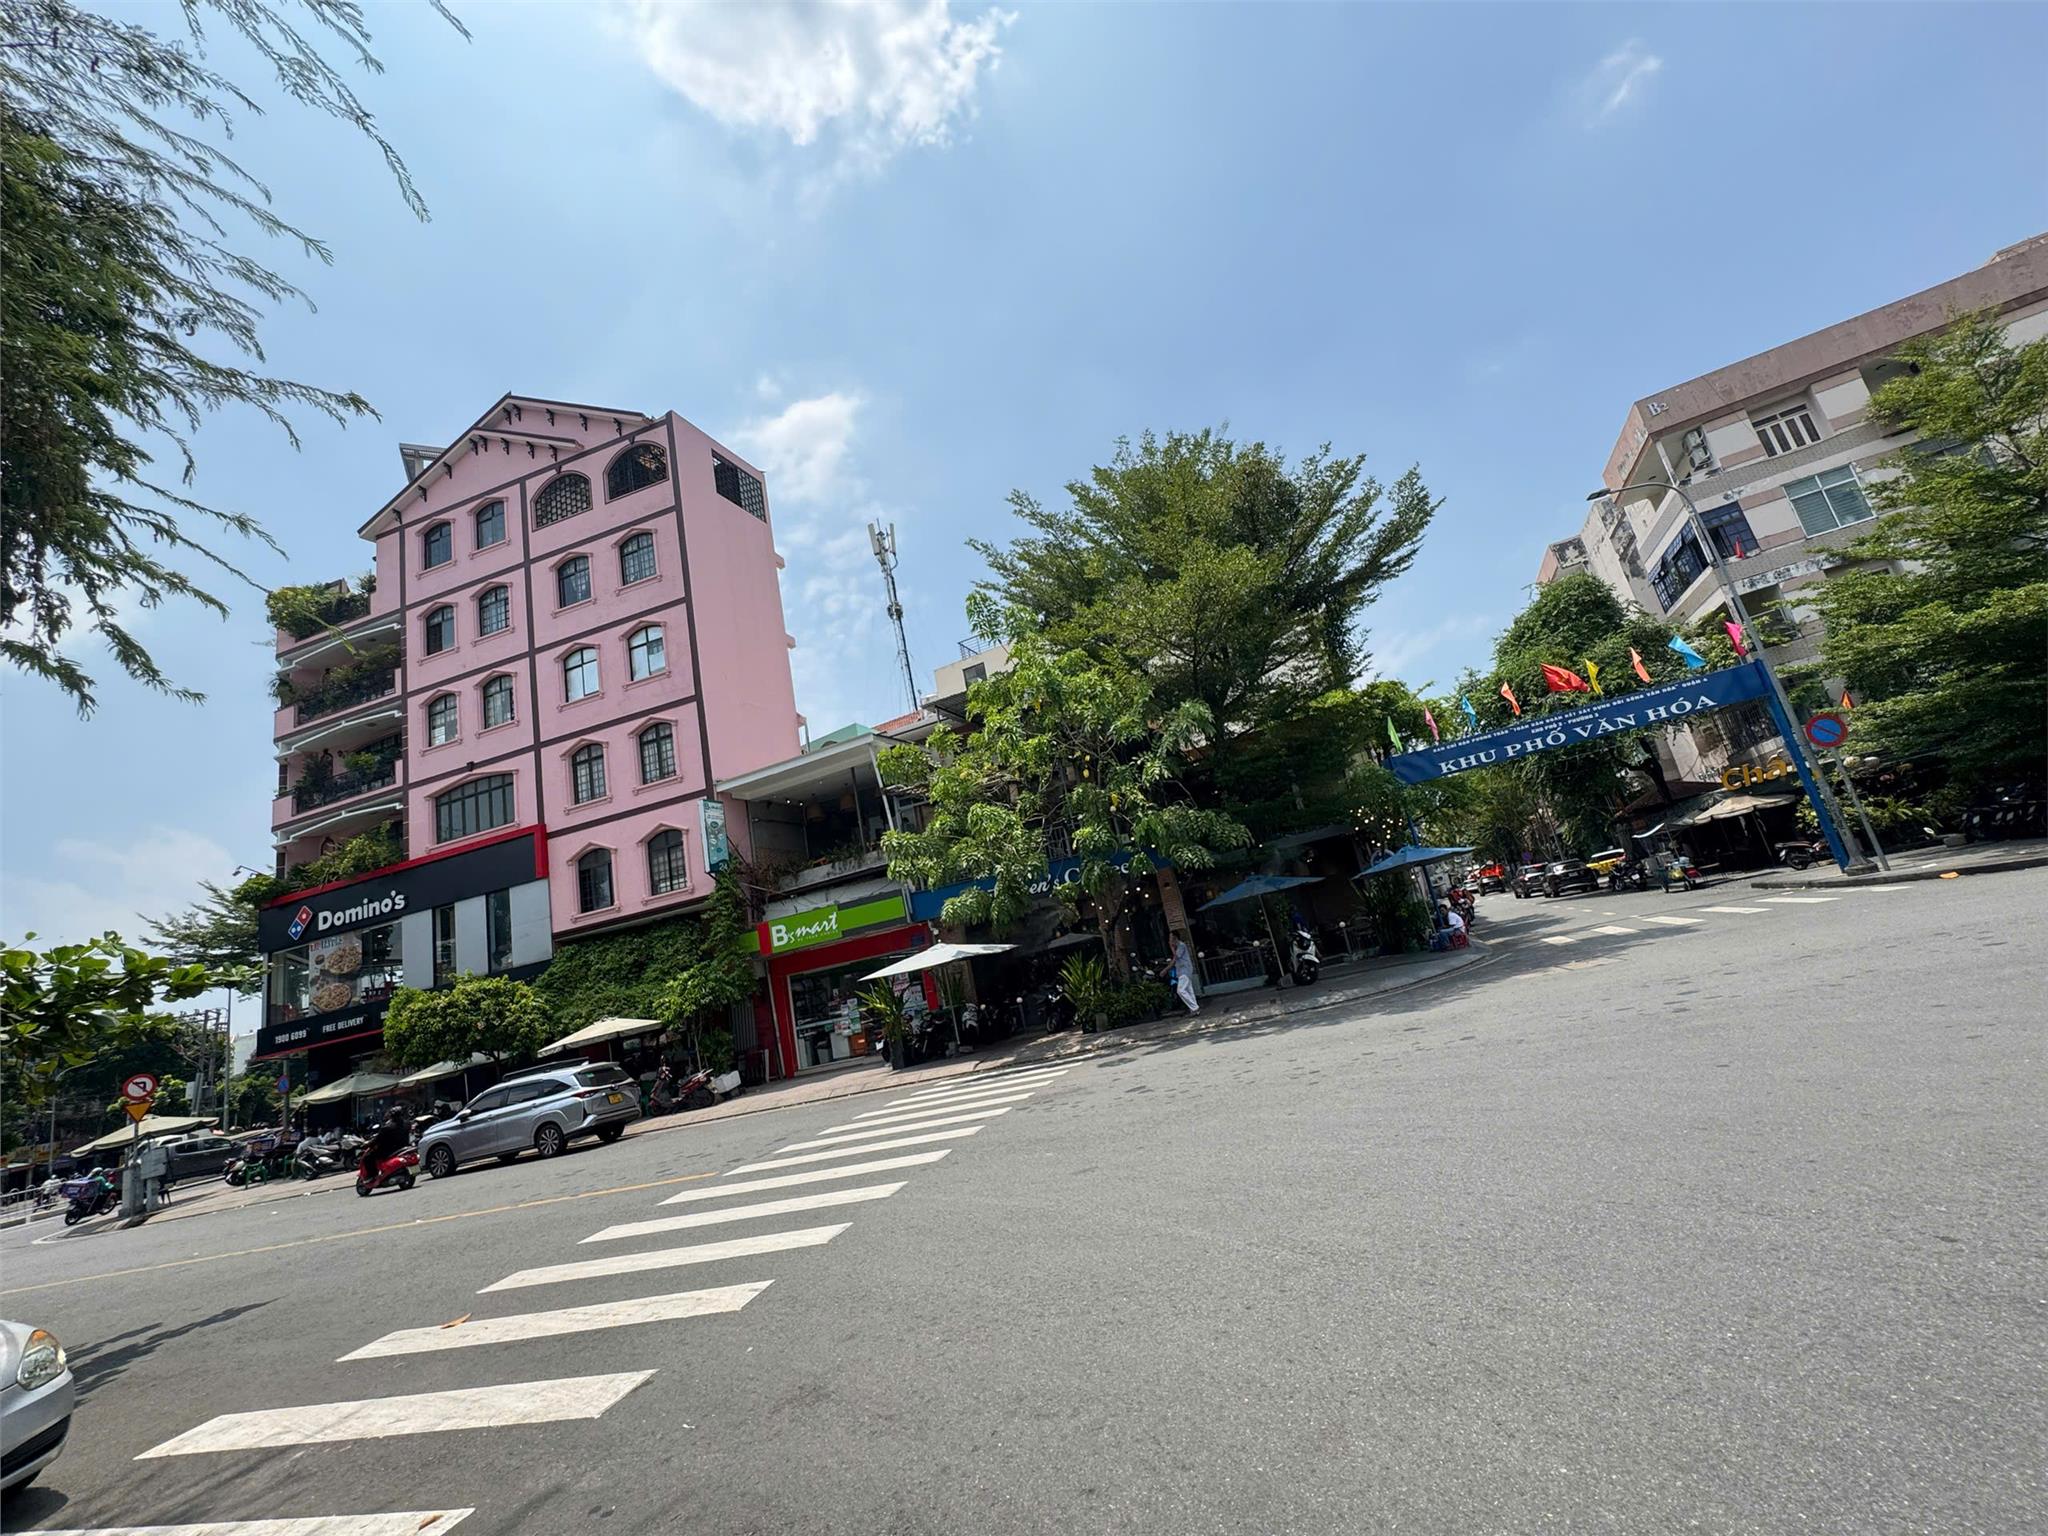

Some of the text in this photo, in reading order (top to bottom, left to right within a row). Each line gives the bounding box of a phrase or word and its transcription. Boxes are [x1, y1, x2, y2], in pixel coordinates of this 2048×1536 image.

[1647, 402, 1669, 416] B2
[1438, 695, 1718, 775] KHU PHỐ VĂN HÓA
[318, 890, 405, 931] Domino's
[322, 1016, 365, 1033] FREE DELIVERY
